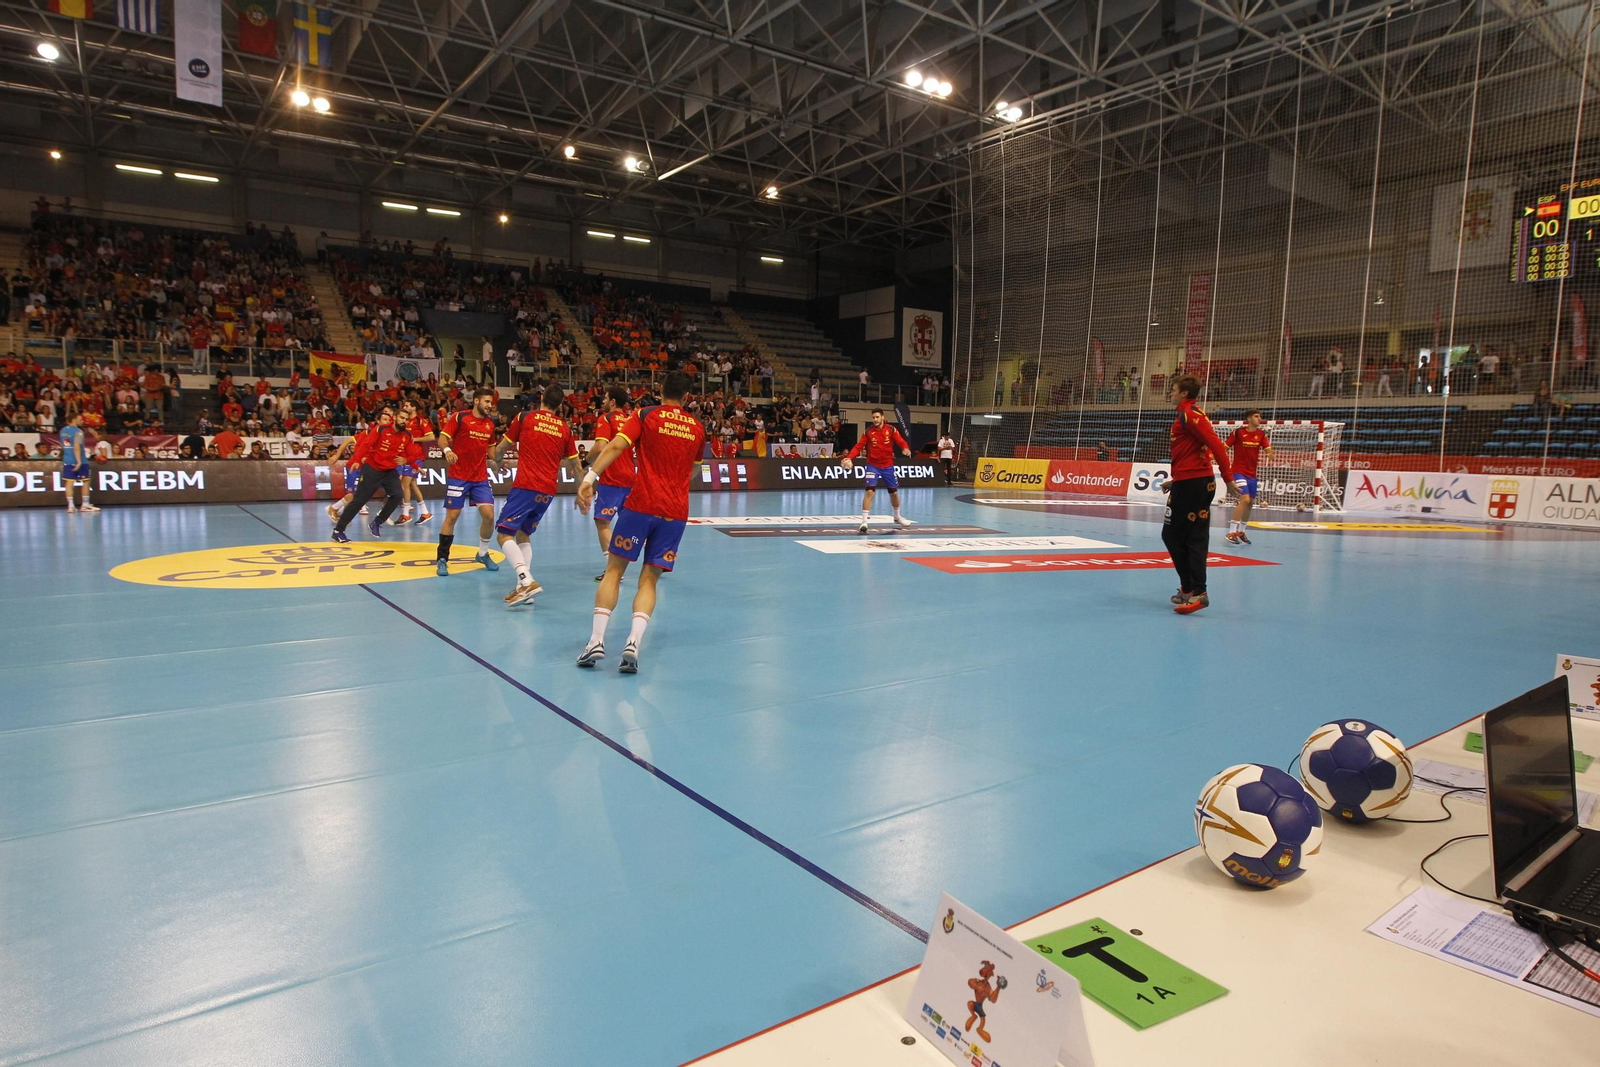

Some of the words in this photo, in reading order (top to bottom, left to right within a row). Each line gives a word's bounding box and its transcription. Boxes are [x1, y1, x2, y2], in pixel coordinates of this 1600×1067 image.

[1538, 195, 1556, 204] ESP
[1533, 219, 1559, 238] 00
[1586, 229, 1594, 241] 1
[1528, 255, 1539, 264] 00
[1528, 264, 1539, 273] 00
[1527, 272, 1538, 281] 00
[664, 421, 690, 433] ESPAÑA
[781, 466, 801, 480] EN
[805, 466, 822, 480] LA
[824, 466, 852, 480] APP
[893, 465, 934, 479] RFEBM
[996, 469, 1044, 485] Correos
[1482, 464, 1513, 475] Men's
[1515, 466, 1538, 476] EHF
[1540, 466, 1576, 477] EURO
[0, 471, 46, 492] DE
[98, 470, 205, 491] RFEBM
[1065, 472, 1124, 488] Santander
[1355, 474, 1477, 504] Andalucía
[601, 507, 615, 516] GO
[1543, 505, 1600, 521] CIUDA
[614, 534, 633, 551] GO
[1062, 936, 1149, 983] T
